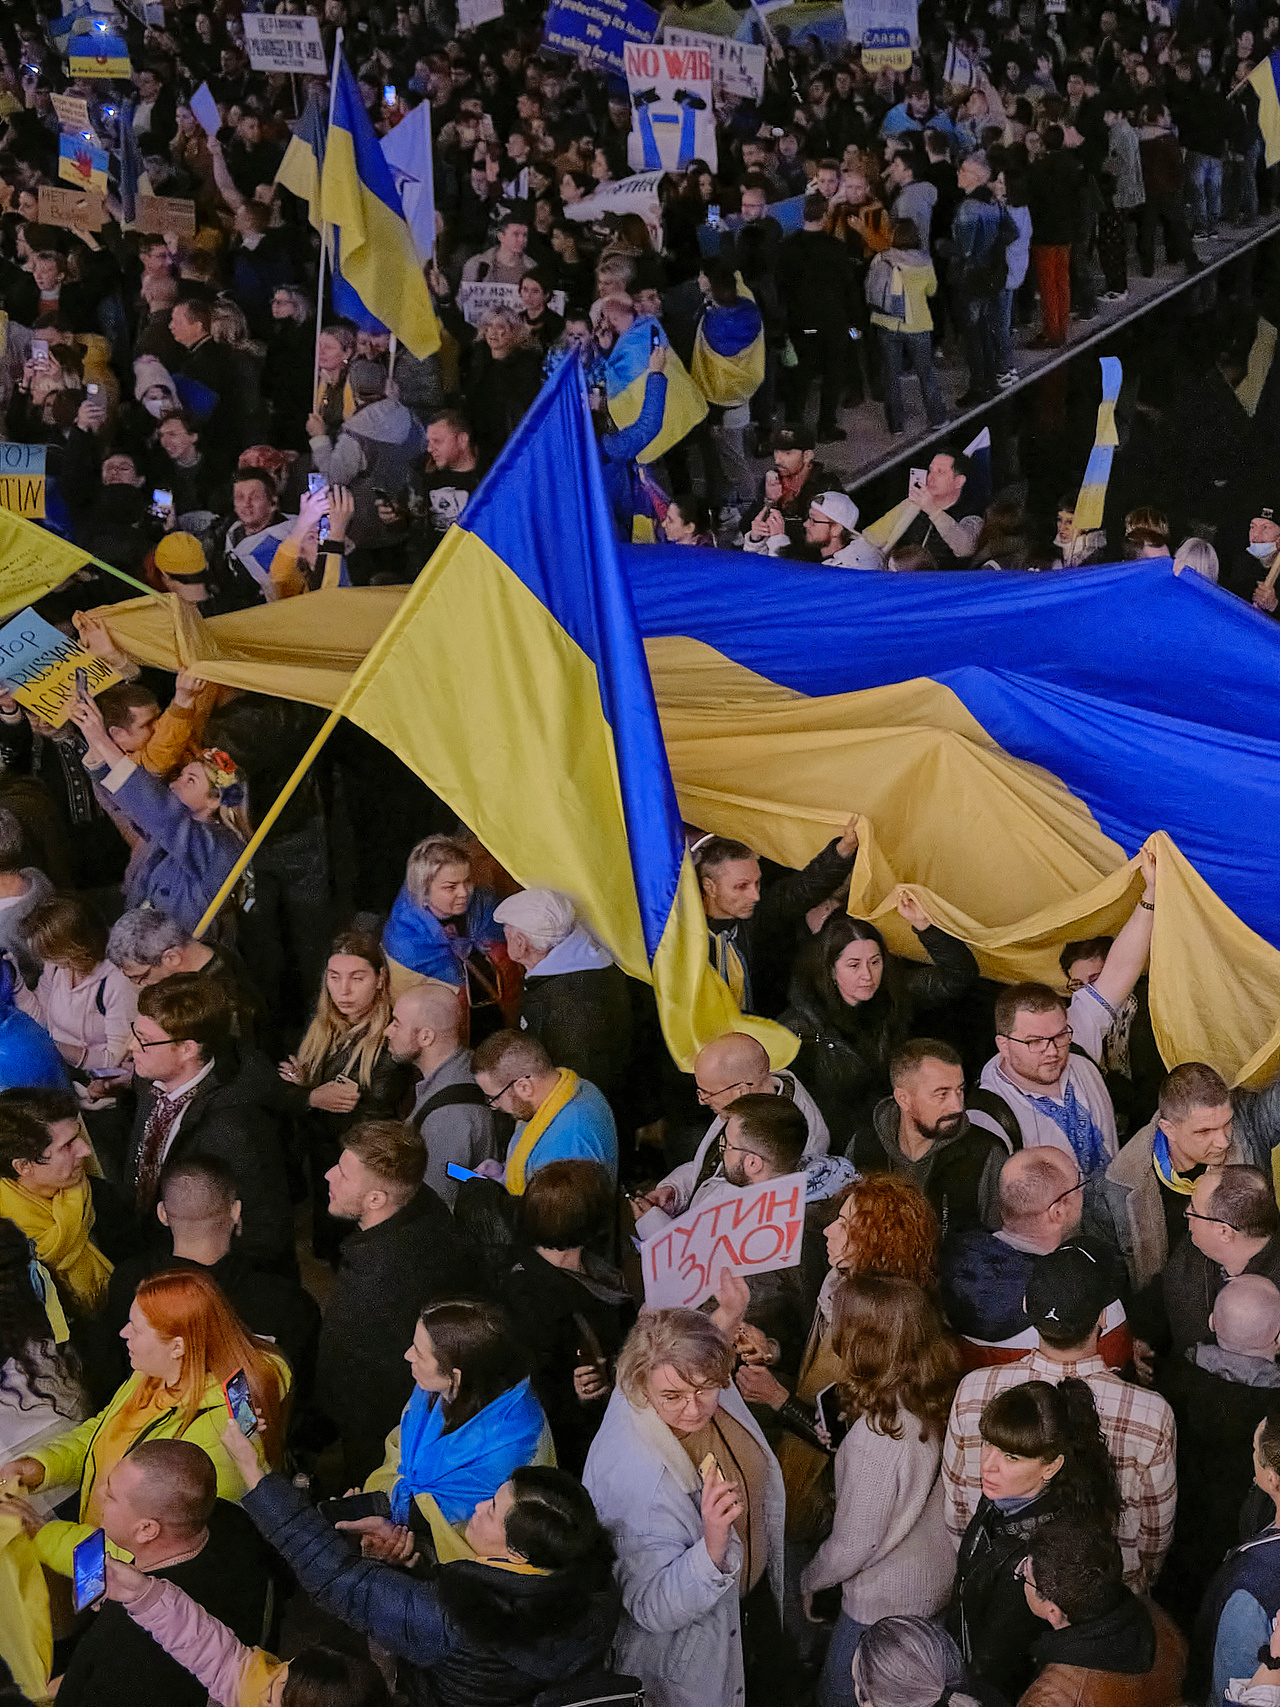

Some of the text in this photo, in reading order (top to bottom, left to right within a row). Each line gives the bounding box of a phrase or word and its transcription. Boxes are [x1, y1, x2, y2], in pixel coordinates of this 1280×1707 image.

[627, 45, 711, 80] NO WAR
[4, 443, 42, 469] OP
[7, 637, 86, 692] RUSSIAN
[651, 1186, 799, 1282] ПУТИН
[678, 1219, 801, 1305] ЗЛО!
